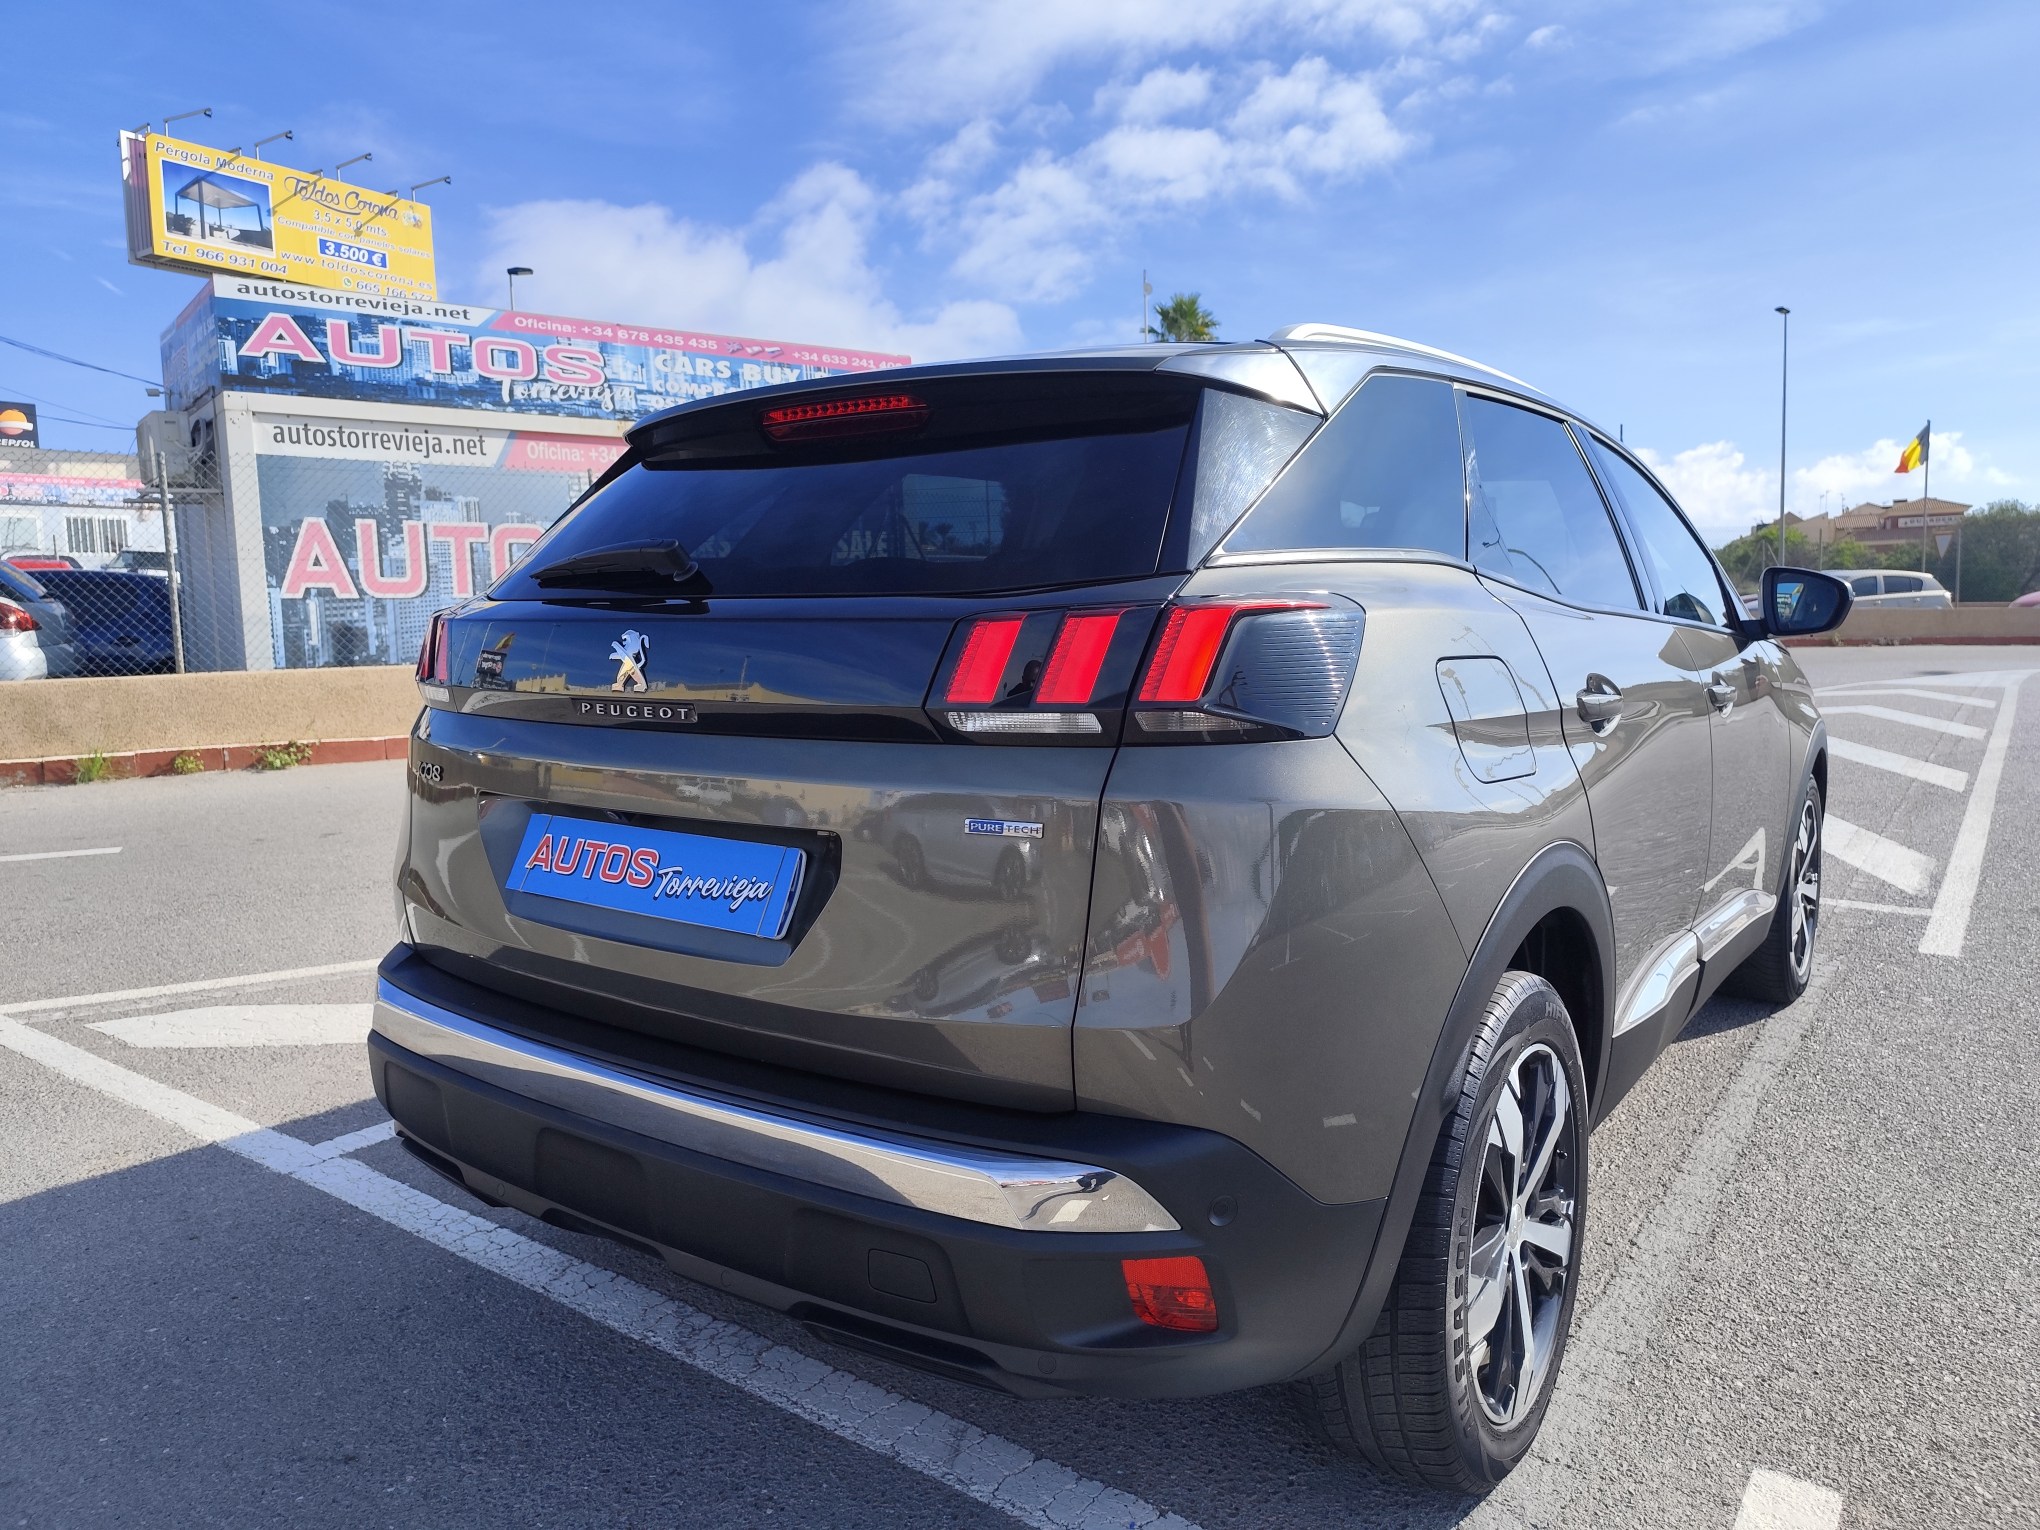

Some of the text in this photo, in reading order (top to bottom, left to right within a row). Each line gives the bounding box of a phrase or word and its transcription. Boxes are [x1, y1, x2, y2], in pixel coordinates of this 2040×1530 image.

[155, 141, 274, 181] Pérgola Moderna
[345, 191, 399, 220] Corona
[277, 216, 335, 236] Compatible
[359, 236, 396, 250] paneles
[398, 245, 431, 258] solares
[196, 248, 224, 262] 966
[229, 255, 255, 268] 931
[260, 261, 288, 274] 004
[324, 241, 383, 267] 3.500 €
[237, 281, 471, 322] autostorrevieja.net
[356, 281, 380, 294] 665
[386, 287, 407, 299] 166
[514, 315, 718, 350] Oficina: +34 678 435 435
[238, 311, 606, 387] AUTOS
[792, 351, 819, 362] +34
[822, 353, 848, 365] 633
[851, 357, 876, 369] 241
[654, 354, 801, 383] CARS BUY
[500, 377, 636, 412] Torrevieja
[0, 438, 35, 448] EPSOL
[272, 423, 487, 459] autostorrevieja.net
[527, 441, 584, 462] Oficina:
[581, 702, 688, 720] PEUGEOT
[525, 833, 774, 911] AUTOS Torrevieja
